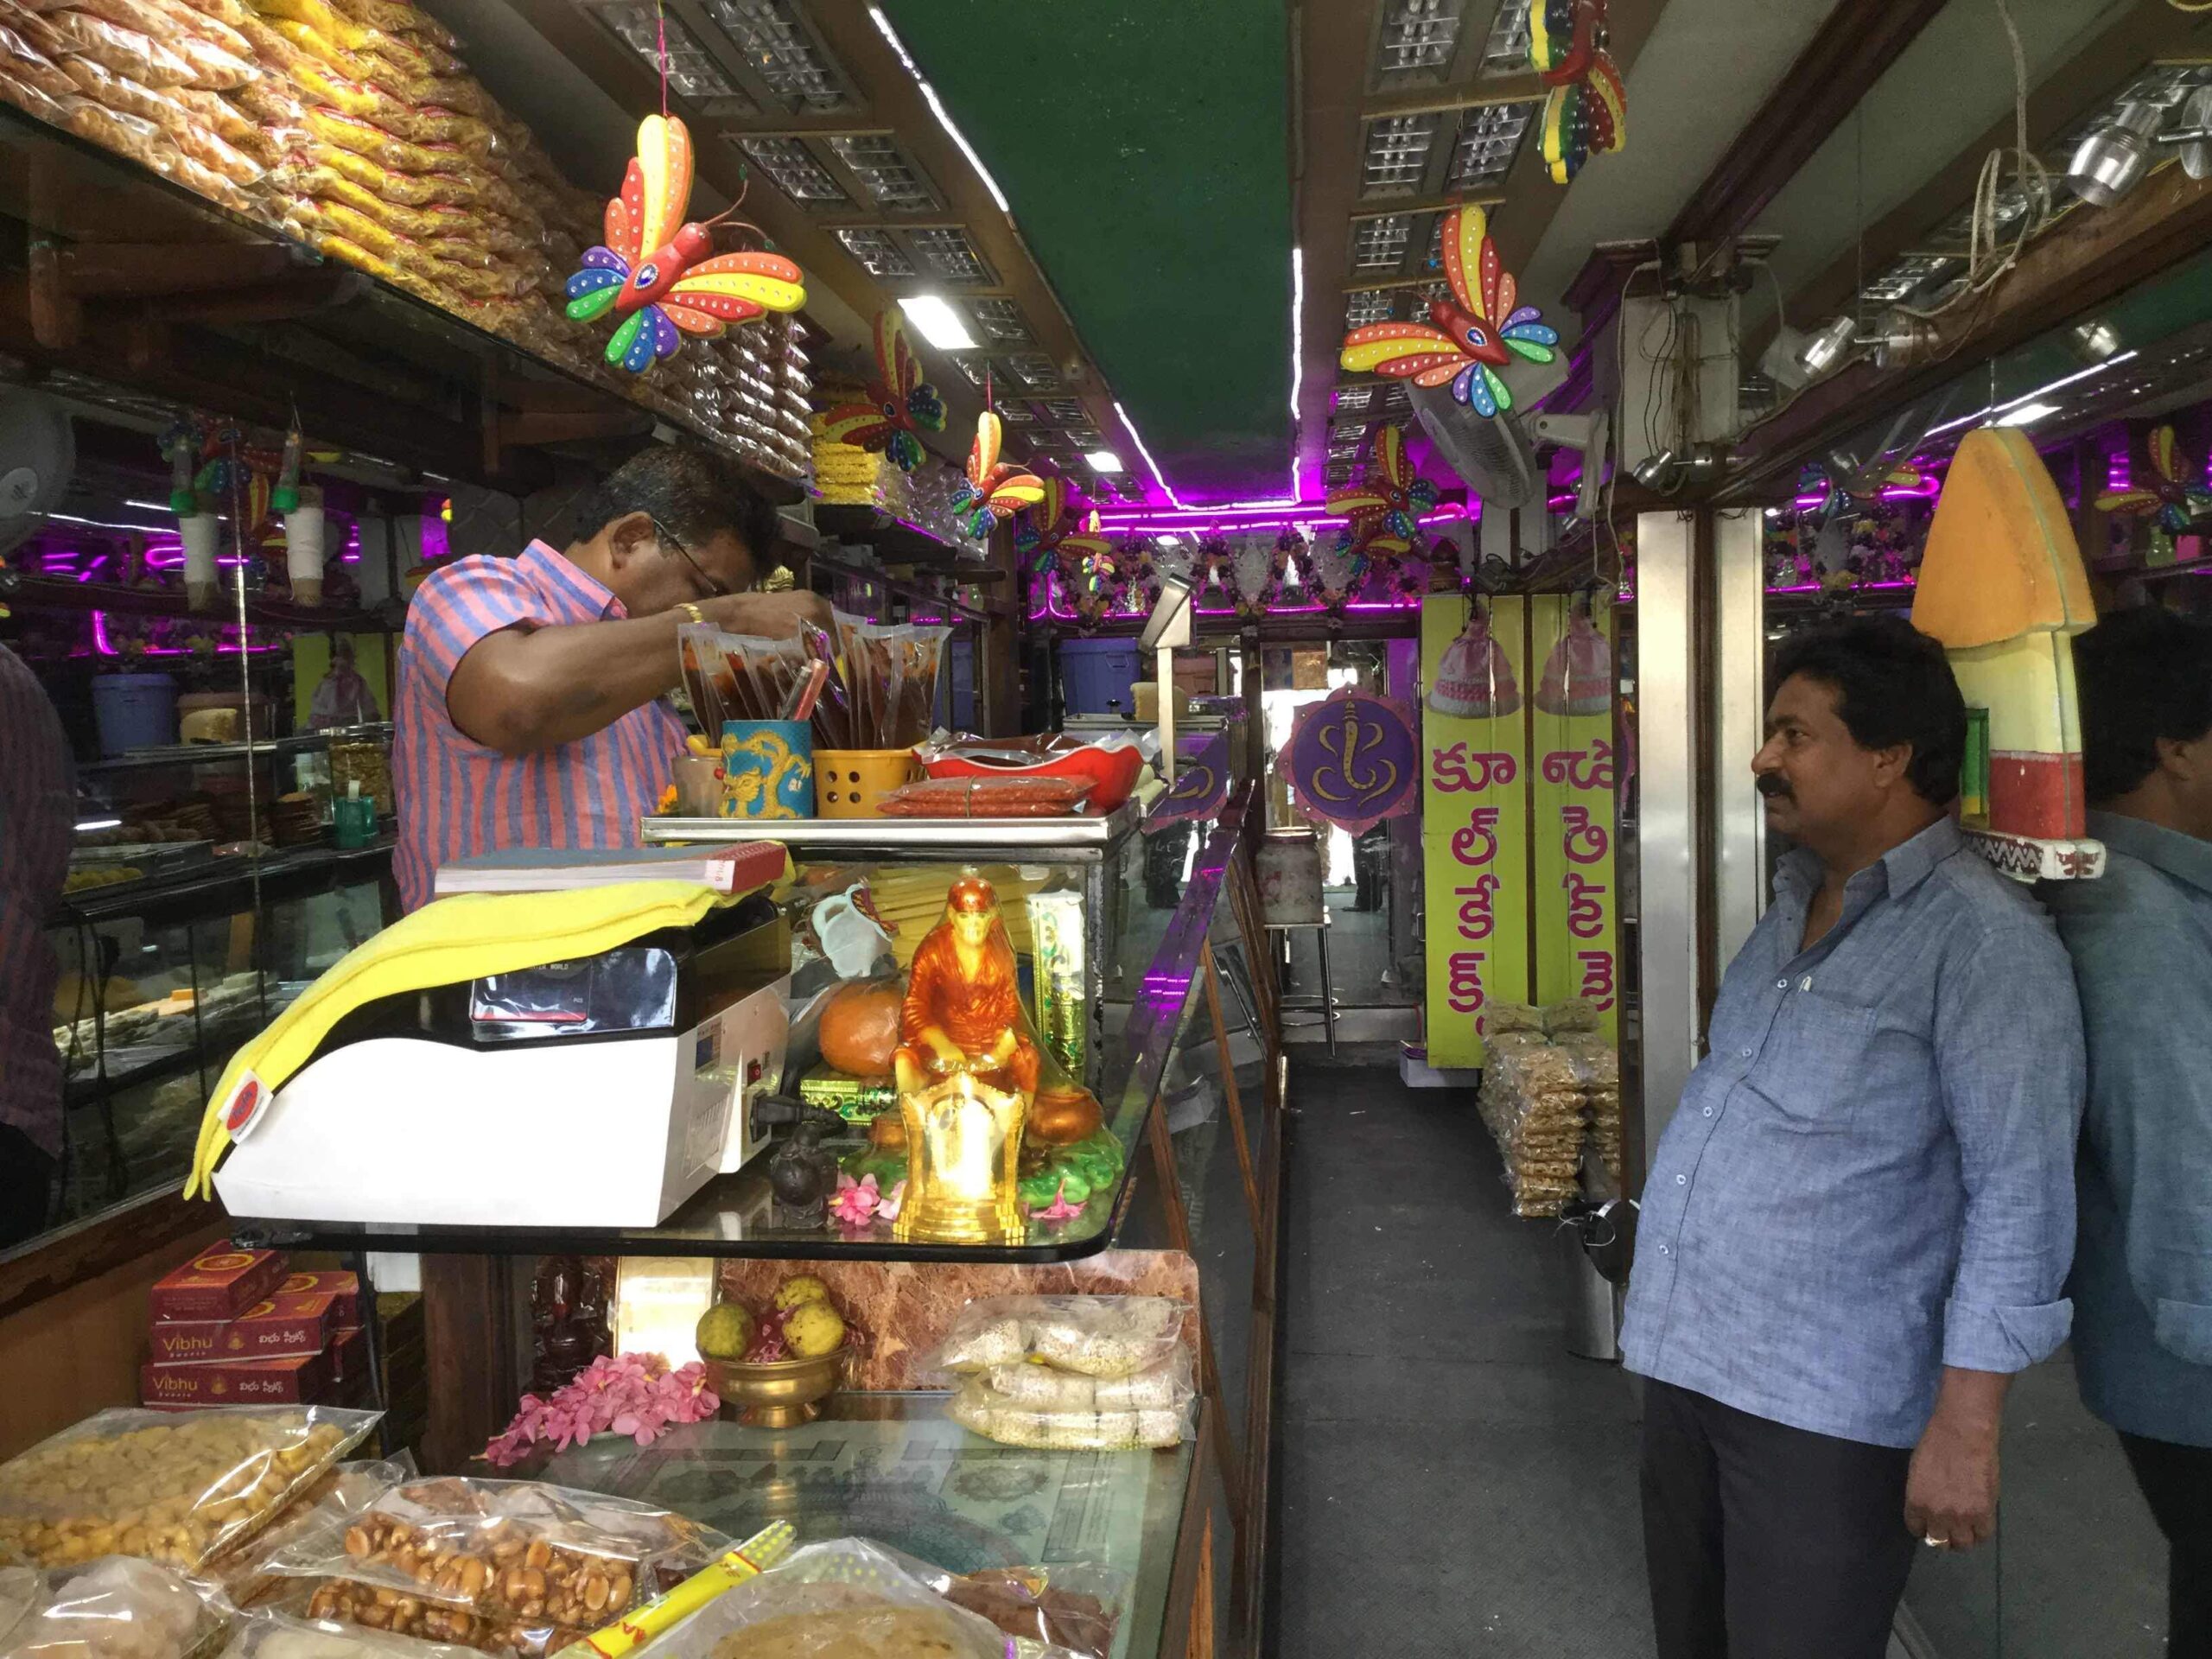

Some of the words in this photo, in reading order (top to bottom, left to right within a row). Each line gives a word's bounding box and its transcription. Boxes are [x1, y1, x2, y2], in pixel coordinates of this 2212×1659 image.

[1431, 741, 1516, 866] కూల్
[162, 1333, 213, 1351] Vibhu
[152, 1374, 198, 1391] Vibhu
